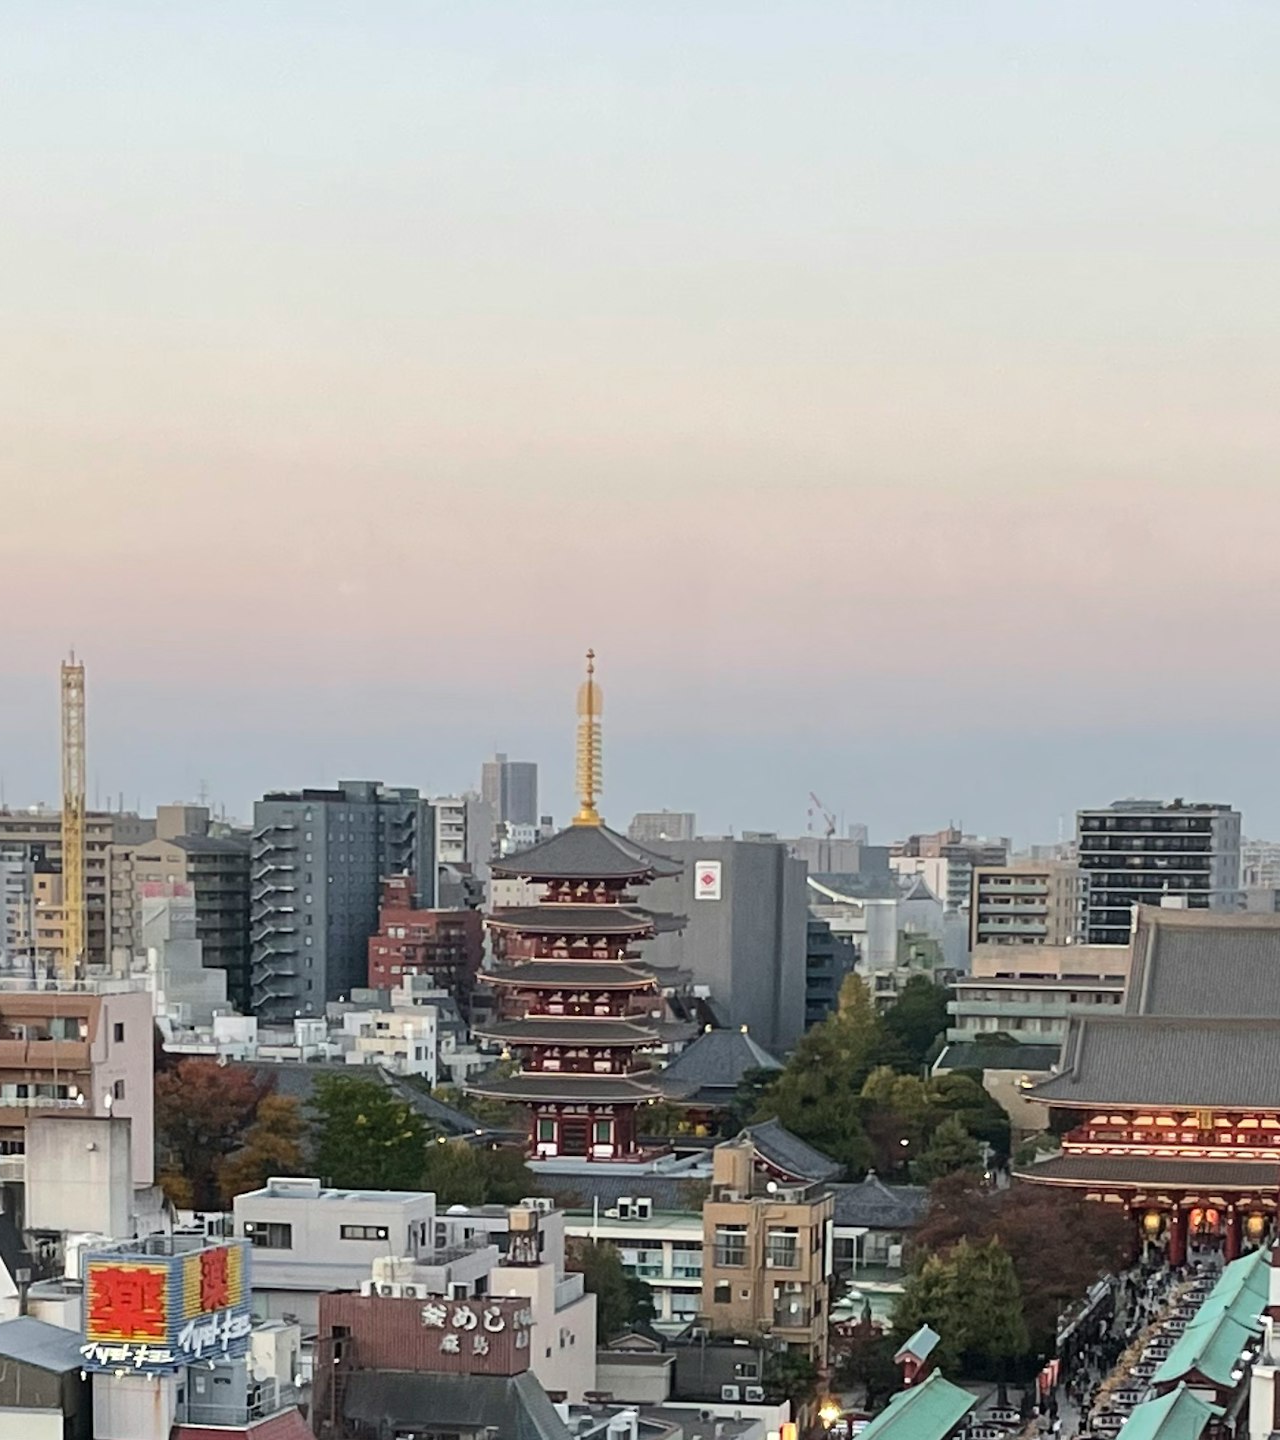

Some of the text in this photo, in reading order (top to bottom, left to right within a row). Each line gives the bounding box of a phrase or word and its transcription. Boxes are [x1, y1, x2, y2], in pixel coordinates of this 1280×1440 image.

[90, 1267, 166, 1338] 薬
[421, 1303, 505, 1332] 釜めし
